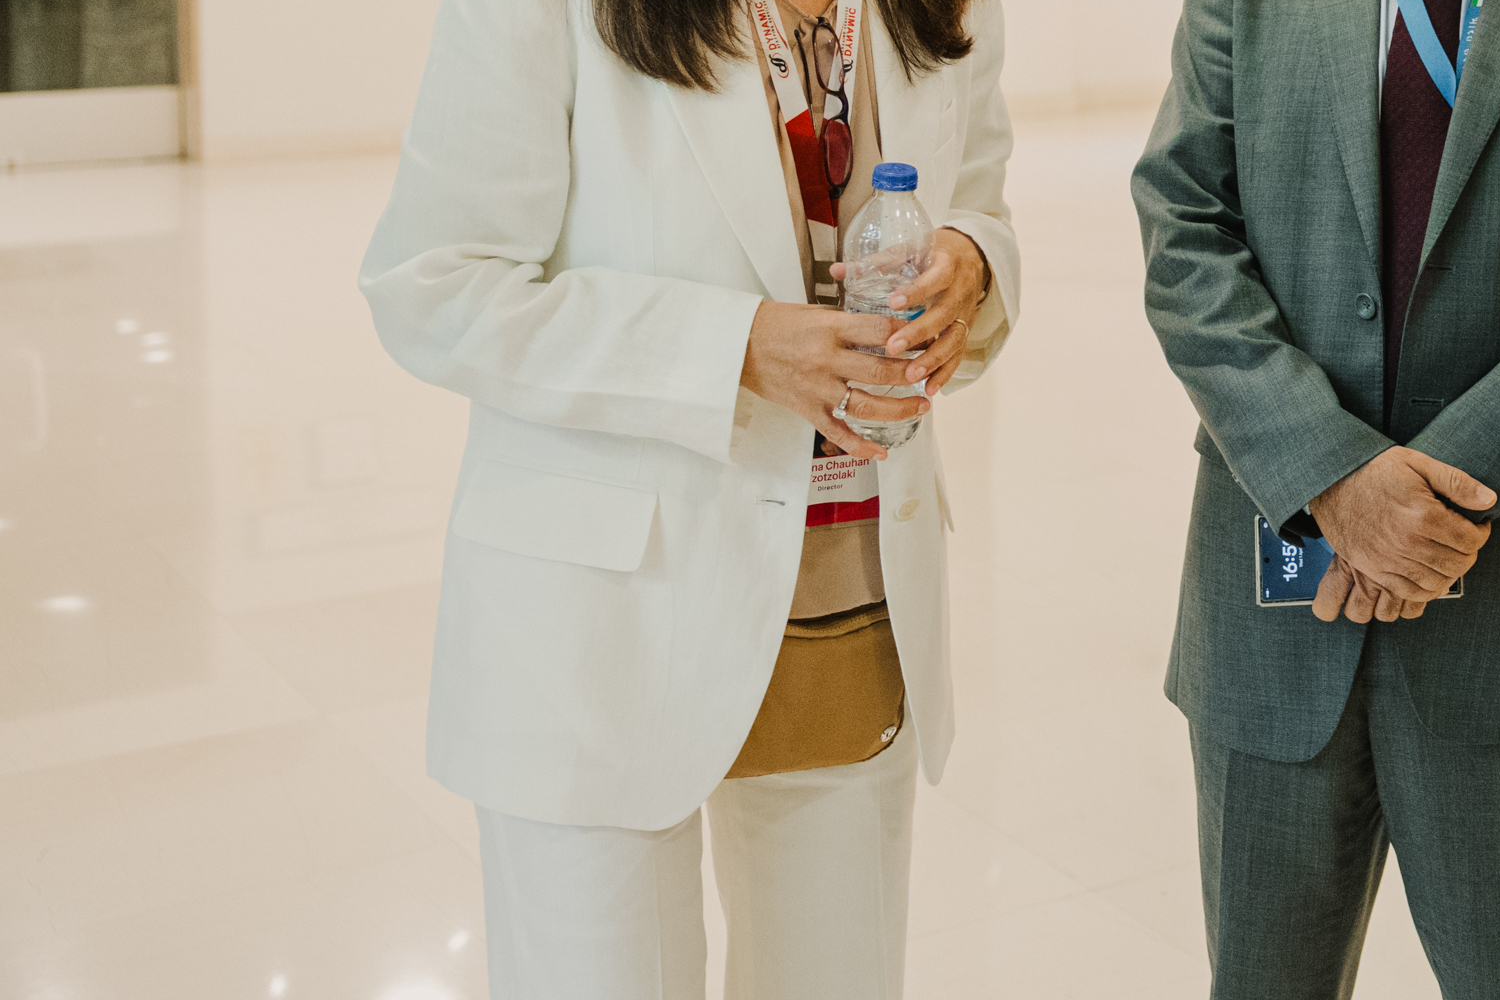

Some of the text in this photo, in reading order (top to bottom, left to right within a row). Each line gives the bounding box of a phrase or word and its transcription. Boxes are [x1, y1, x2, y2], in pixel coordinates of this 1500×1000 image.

[755, 1, 778, 51] DYNAMIC
[825, 458, 870, 470] Chauhan
[811, 469, 856, 483] zotzolaki
